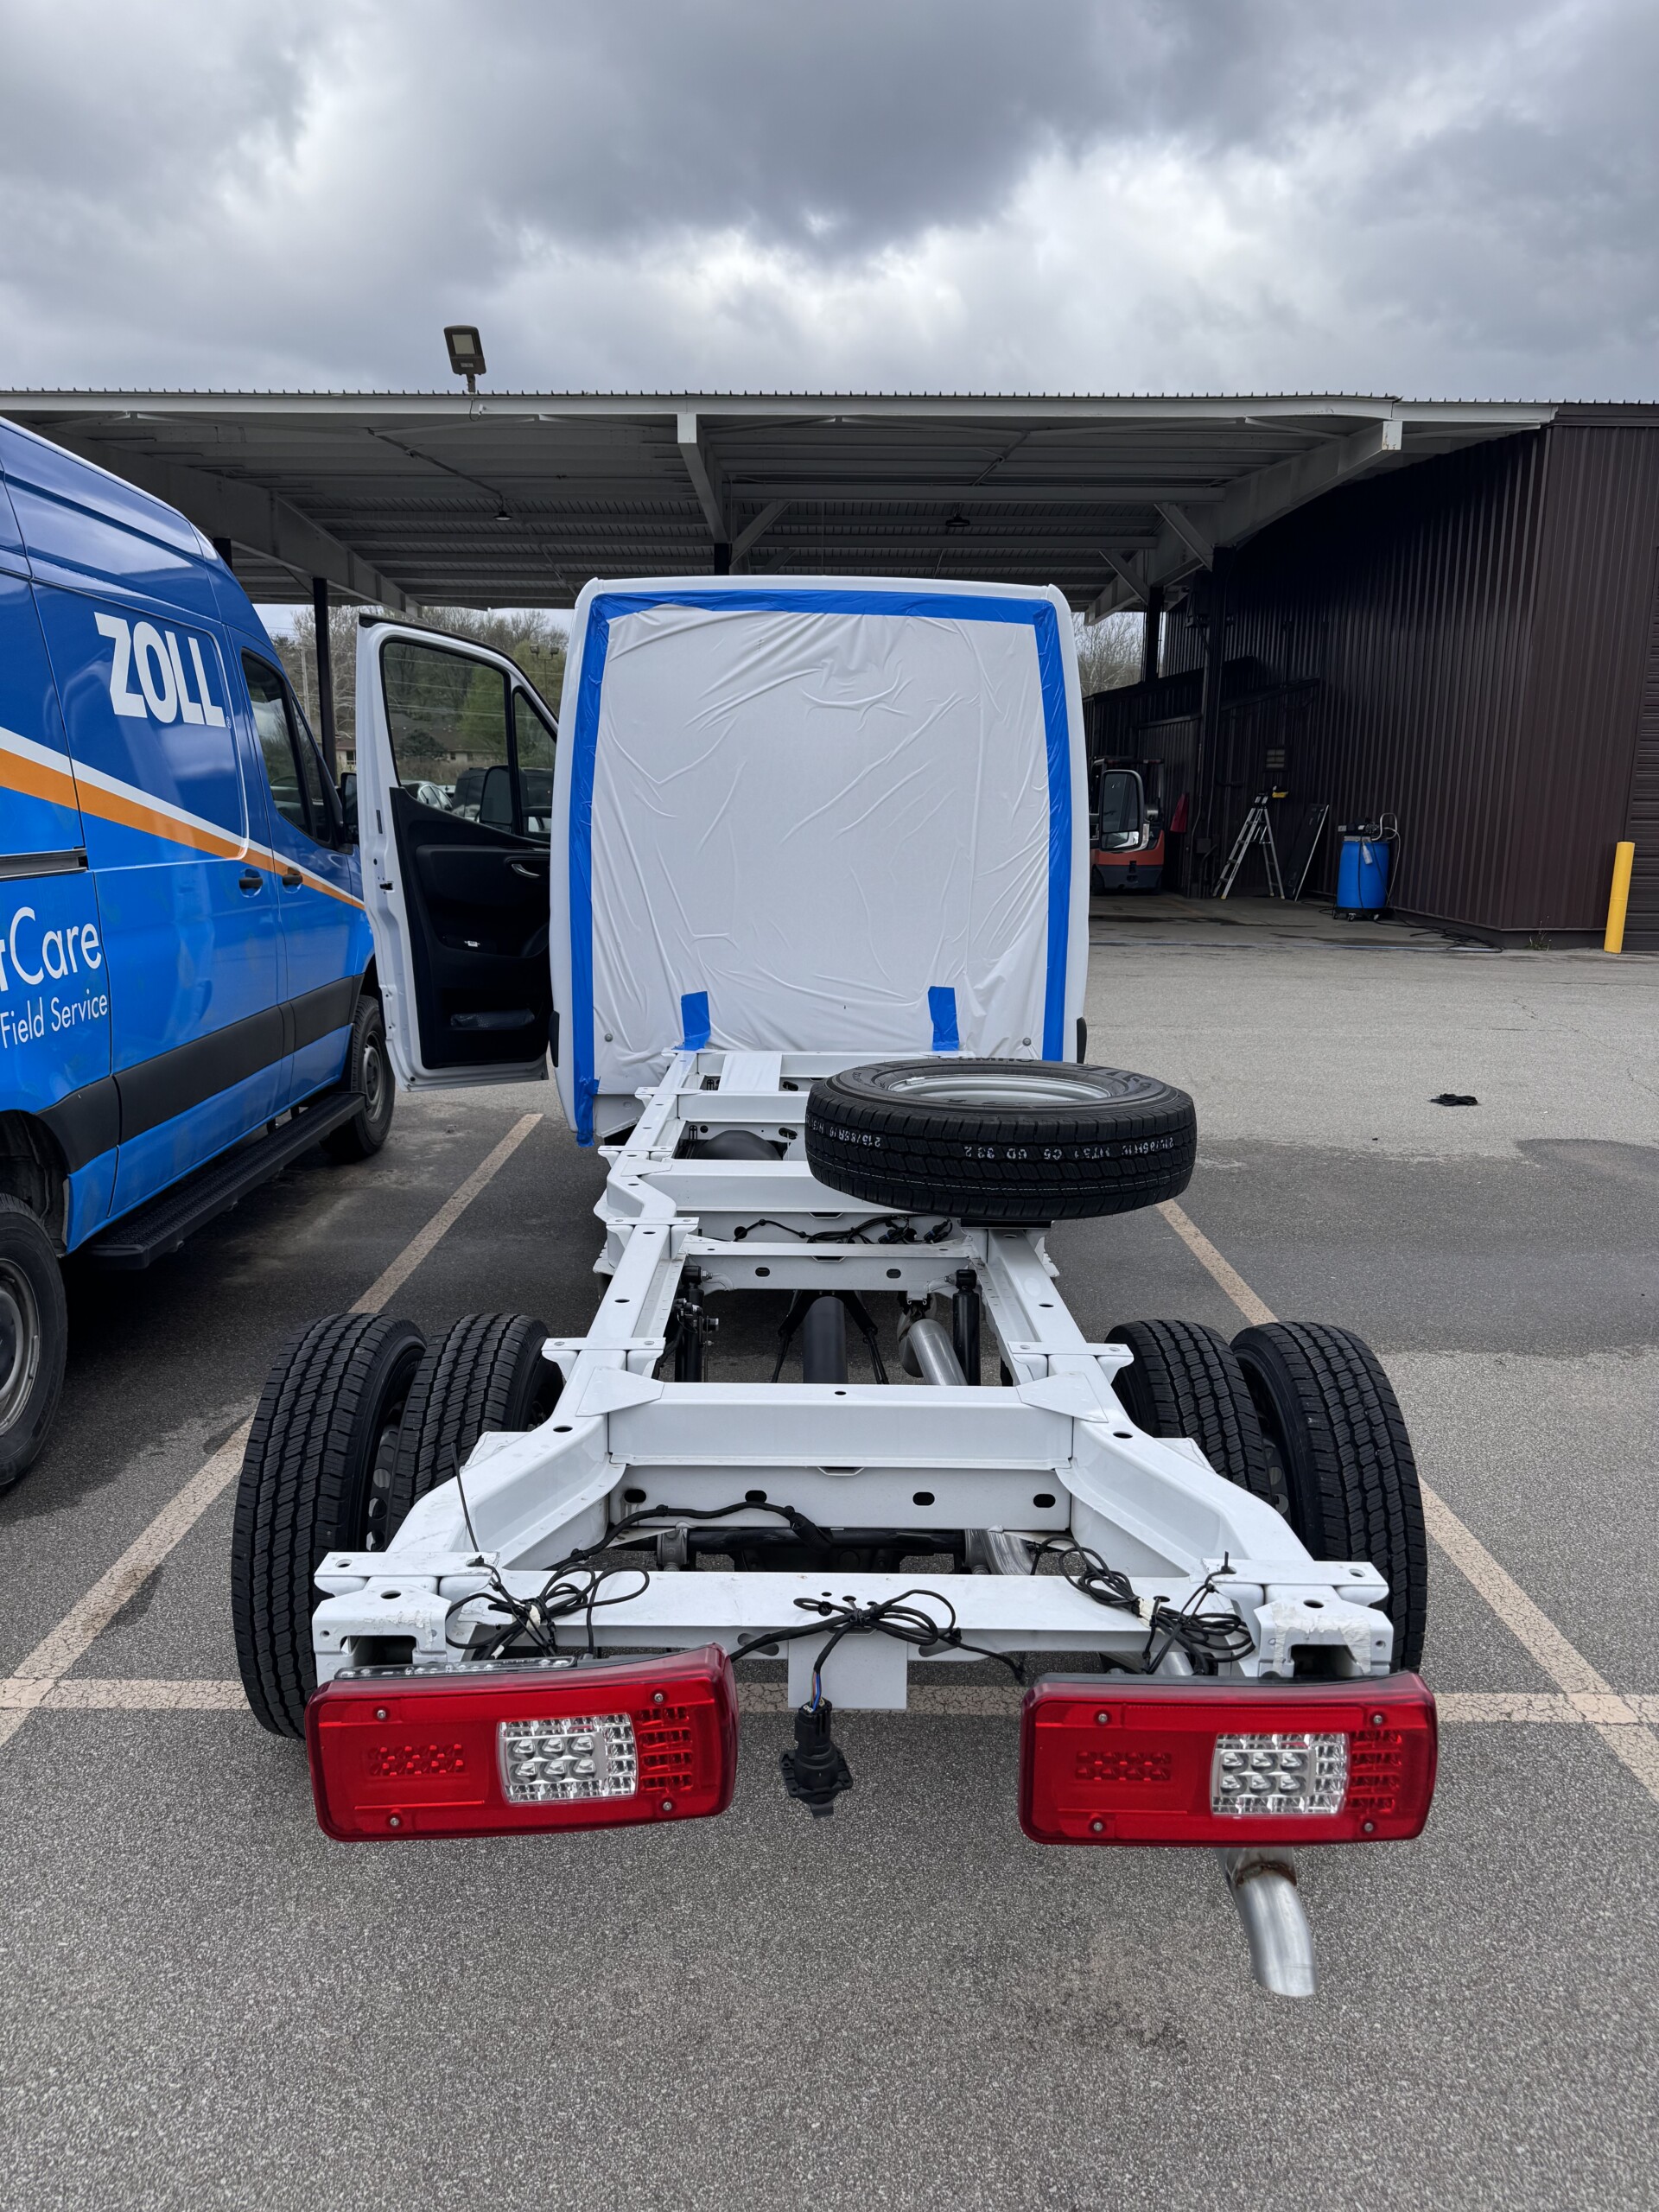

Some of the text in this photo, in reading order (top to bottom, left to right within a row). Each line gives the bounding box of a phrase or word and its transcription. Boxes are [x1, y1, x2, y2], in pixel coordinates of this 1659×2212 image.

[94, 611, 226, 728] ZOLL
[0, 988, 108, 1049] Field Service
